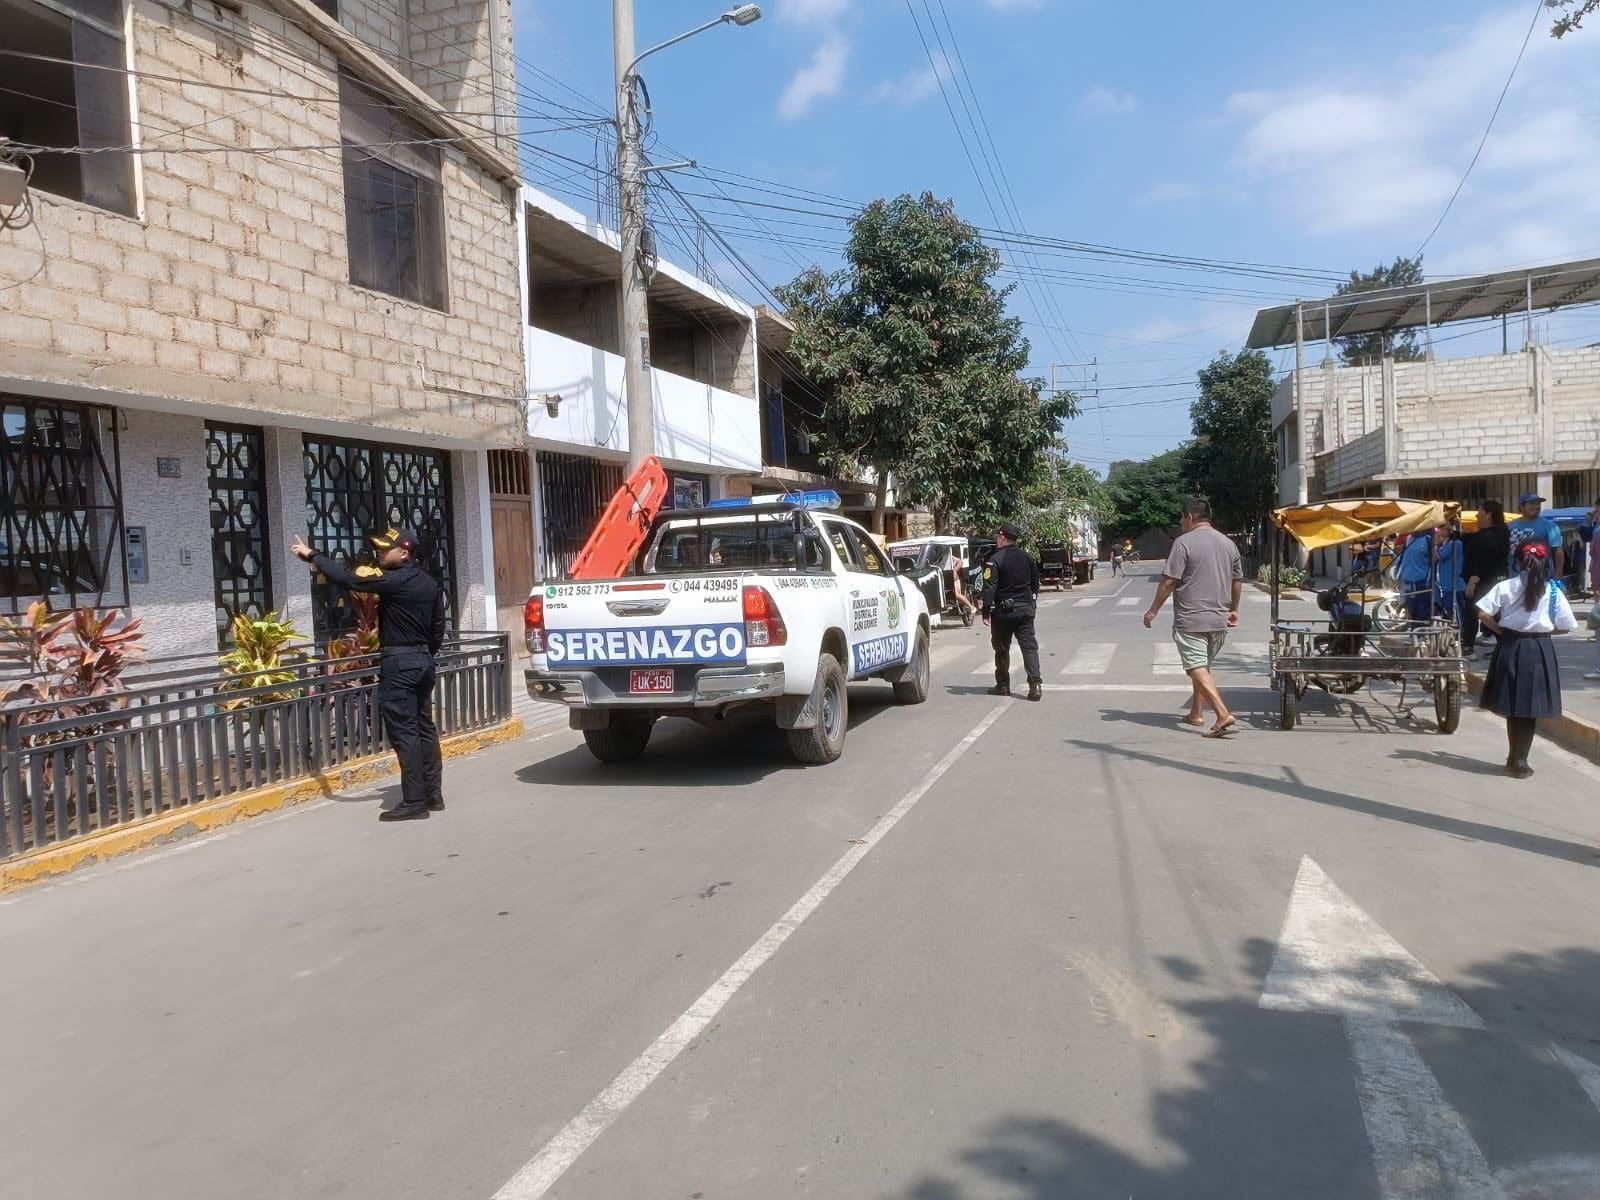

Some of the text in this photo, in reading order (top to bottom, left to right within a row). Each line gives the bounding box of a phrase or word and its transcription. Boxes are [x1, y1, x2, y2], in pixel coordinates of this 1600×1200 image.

[558, 585, 610, 596] 912 562 773
[684, 579, 738, 592] 044 439495
[547, 626, 744, 662] SERENAZGO
[858, 635, 905, 670] SERENAZGO
